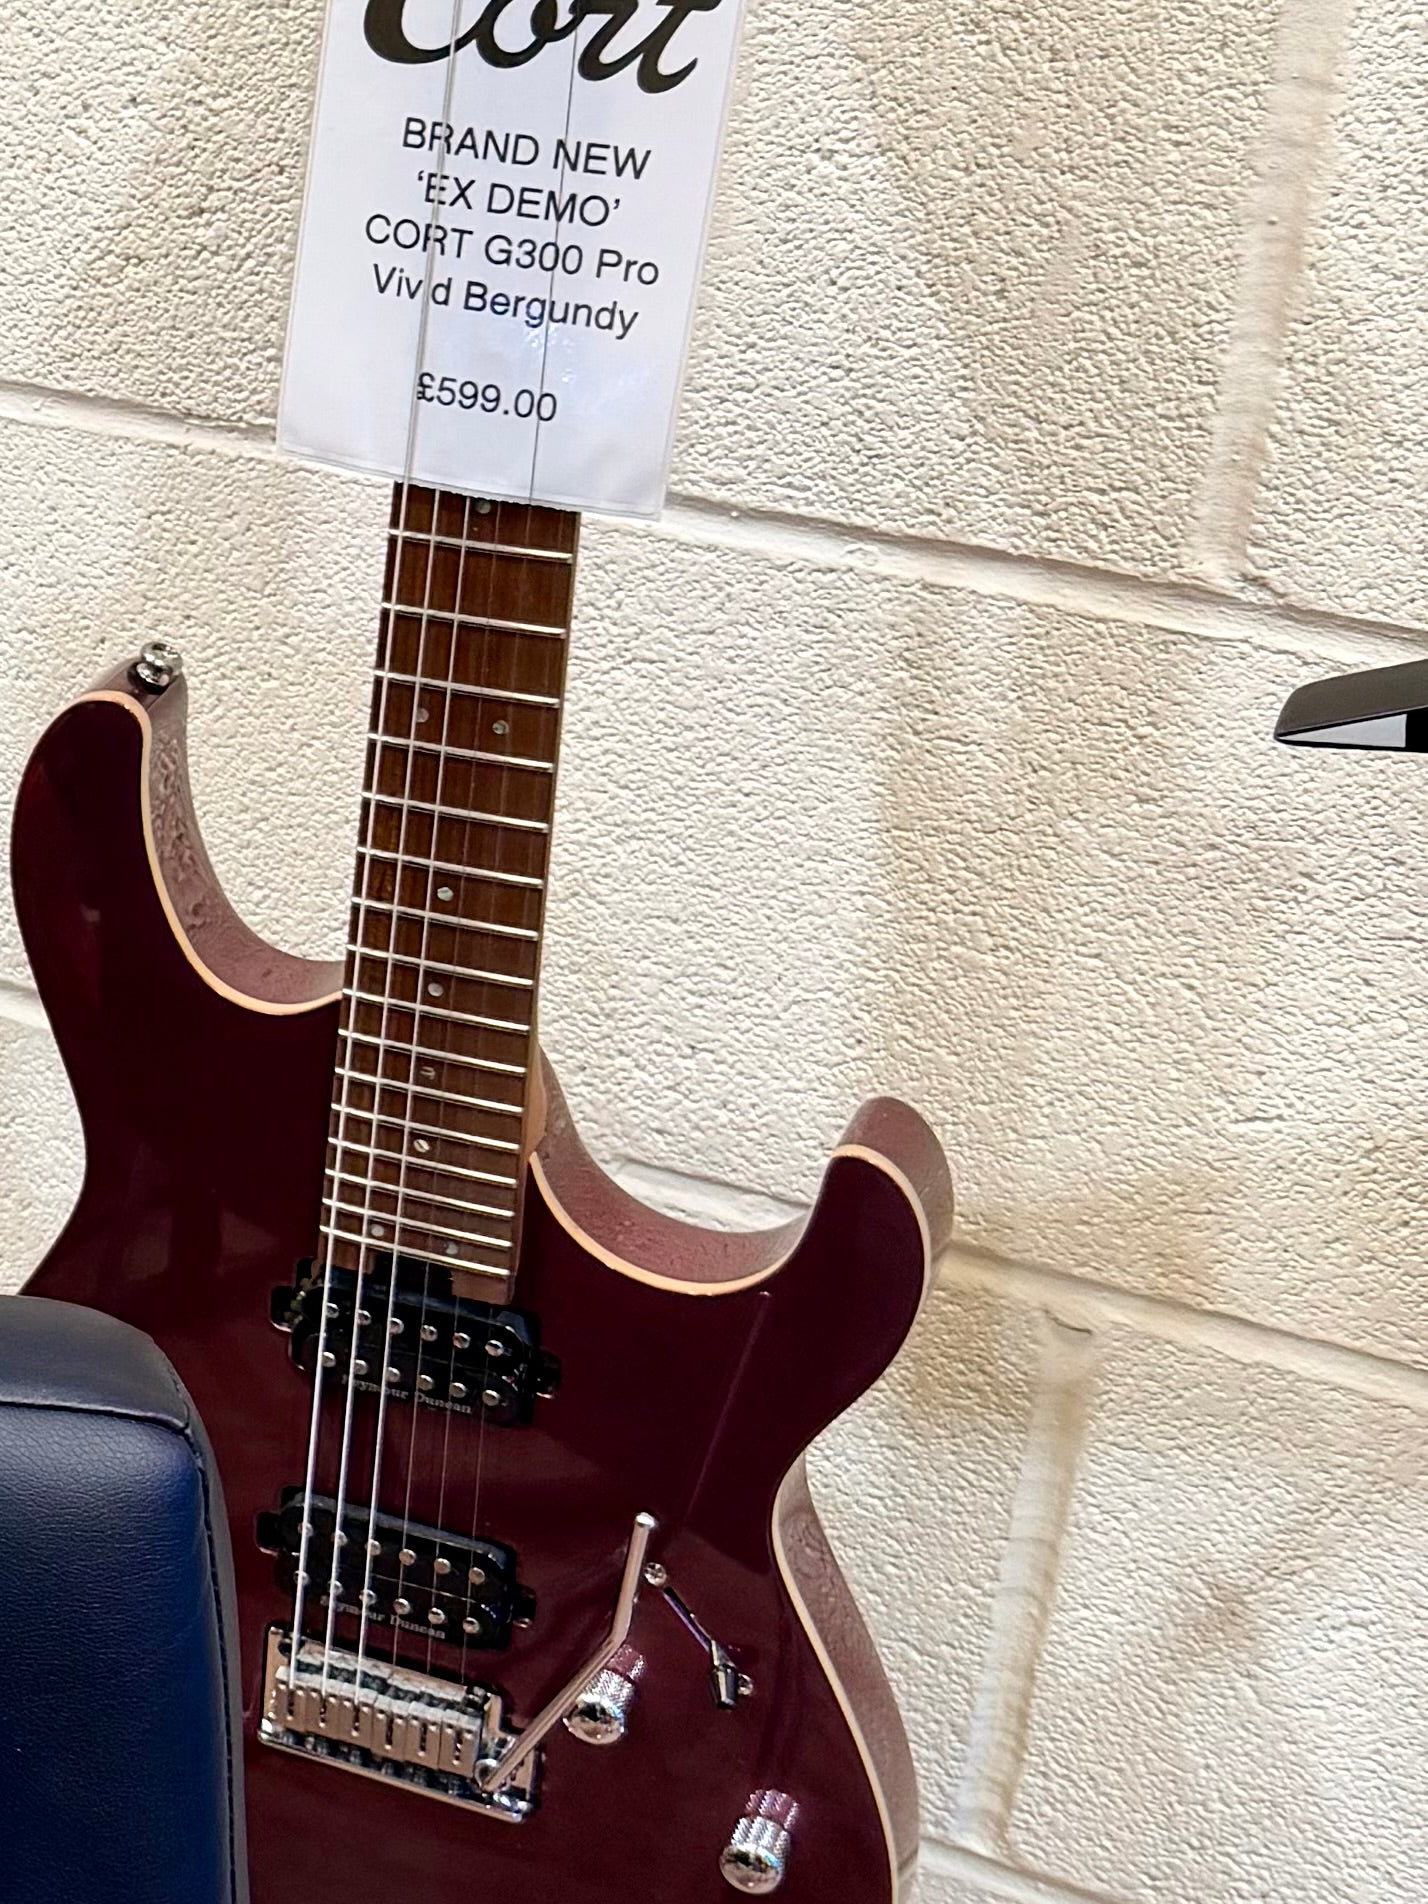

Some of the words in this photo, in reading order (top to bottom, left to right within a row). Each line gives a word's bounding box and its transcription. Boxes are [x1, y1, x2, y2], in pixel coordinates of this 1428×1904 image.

[402, 116, 540, 166] BRAND
[552, 139, 652, 180] NEW
[365, 213, 474, 258] CORT
[484, 234, 584, 275] G300
[595, 248, 660, 286] Pro
[373, 262, 453, 306] Vivd
[463, 280, 640, 340] Bergundy
[416, 371, 558, 422] £599.00
